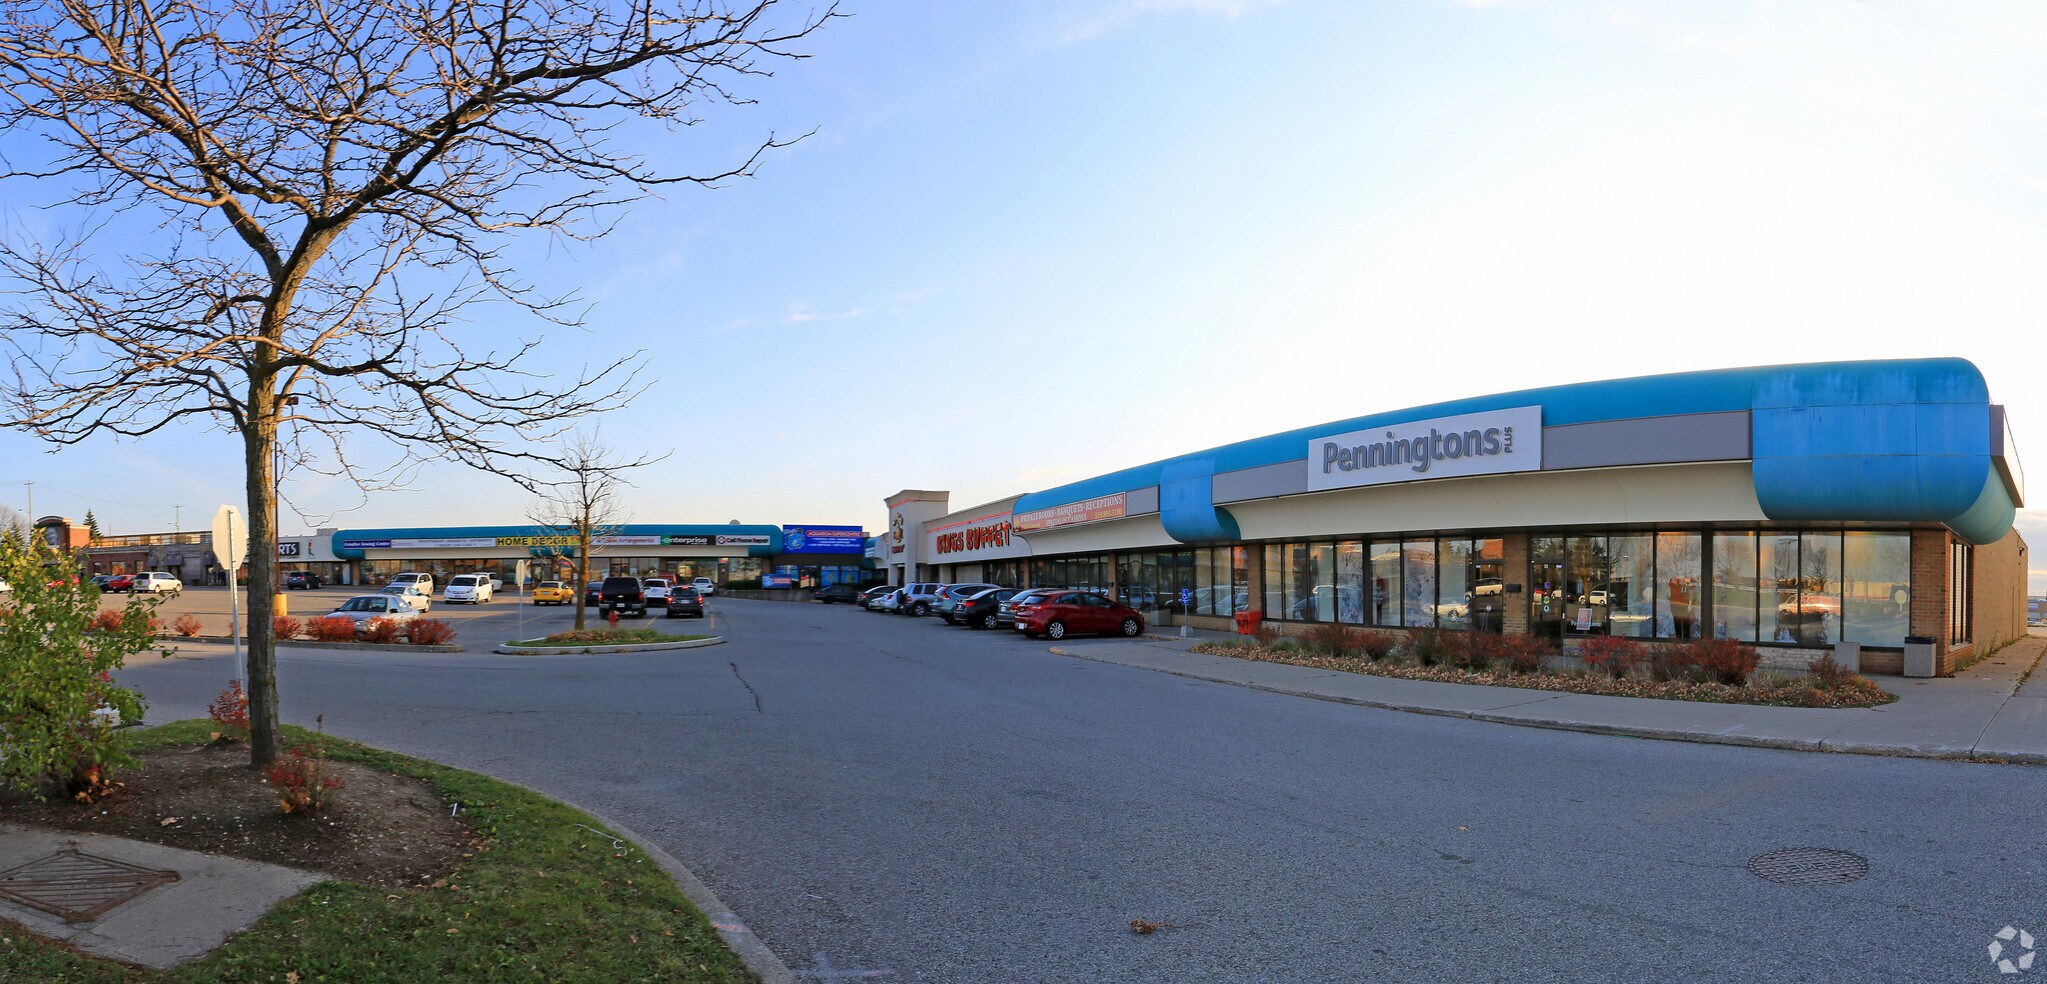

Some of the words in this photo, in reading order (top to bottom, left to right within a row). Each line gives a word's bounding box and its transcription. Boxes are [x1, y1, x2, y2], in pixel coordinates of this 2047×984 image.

[1323, 427, 1501, 473] Penningtons
[1504, 426, 1513, 454] PLUS
[1020, 512, 1039, 523] PRIVATE
[1039, 509, 1055, 520] ROOMS
[1056, 503, 1084, 517] BANQUETS
[1085, 495, 1123, 511] RECEPTIONS
[1045, 517, 1061, 527] SPECIAL
[1061, 513, 1085, 524] OCCASIONS
[497, 537, 528, 545] HOME
[531, 537, 568, 545] DECOR
[664, 536, 707, 544] enterprise
[936, 531, 965, 554] KINGS
[966, 520, 1012, 551] BUFFET
[278, 543, 297, 555] RTS
